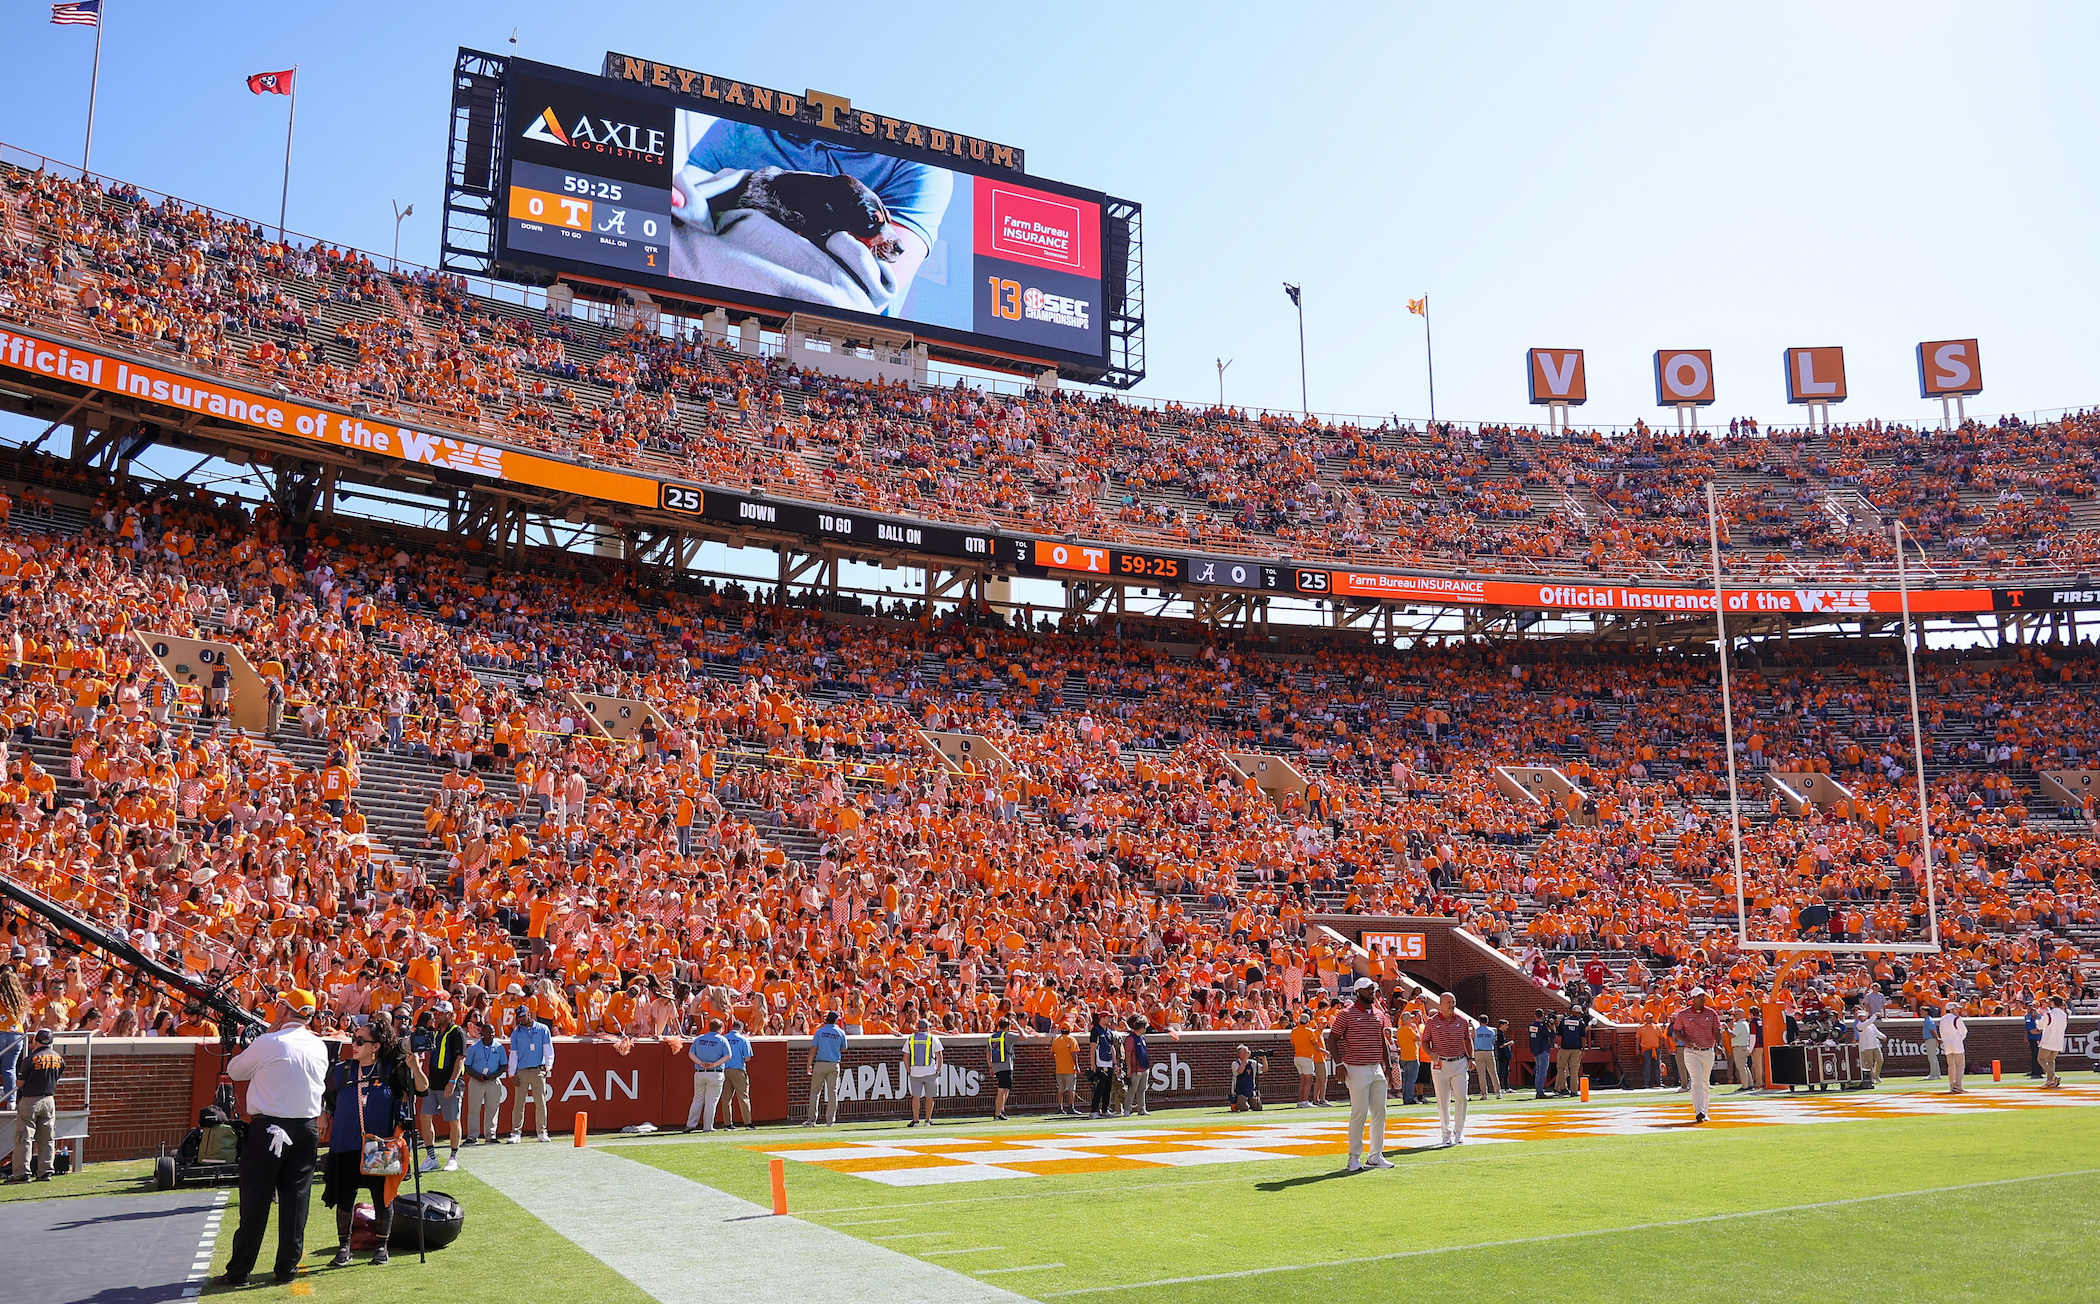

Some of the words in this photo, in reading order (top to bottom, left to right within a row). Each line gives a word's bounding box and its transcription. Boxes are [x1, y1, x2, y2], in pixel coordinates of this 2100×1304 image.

[622, 57, 797, 117] NEYLAND
[859, 112, 1014, 168] STADIUM
[571, 115, 665, 157] AXLE
[572, 139, 664, 166] LOGISTICS
[563, 175, 622, 201] 59:25
[528, 197, 544, 216] 0
[560, 199, 588, 227] T
[643, 219, 657, 237] 0
[1004, 215, 1032, 233] Farm
[1033, 221, 1069, 239] Bureau
[520, 222, 543, 233] DOWN
[560, 229, 571, 238] TO
[572, 231, 582, 240] GO
[600, 237, 615, 247] BALL
[616, 239, 628, 248] ON
[644, 245, 658, 254] QTR
[1003, 226, 1069, 251] INSURANCE
[647, 255, 656, 268] 1
[988, 275, 1022, 322] 13
[1043, 293, 1089, 319] SEC
[1025, 306, 1090, 330] CHAMPIONSHIPS
[117, 364, 283, 429] Insurance
[296, 413, 327, 438] of
[339, 418, 390, 452] the
[667, 486, 699, 511] 25
[739, 501, 776, 523] DOWN
[818, 514, 834, 532] TO
[835, 517, 852, 535] GO
[878, 523, 905, 543] BALL
[906, 528, 922, 546] ON
[965, 535, 986, 554] QTR
[988, 539, 995, 555] 1
[1015, 540, 1028, 549] TOL
[1017, 549, 1026, 561] 3
[1052, 546, 1068, 564] 0
[1083, 548, 1104, 571] T
[1120, 555, 1178, 577] 59:25
[1231, 565, 1247, 584] 0
[1265, 568, 1278, 577] TOL
[1267, 576, 1276, 588] 3
[1301, 572, 1327, 590] 25
[1349, 574, 1377, 588] Farm
[1379, 576, 1416, 589] Bureau
[1417, 578, 1484, 593] INSURANCE
[1539, 586, 1614, 608] Official
[1621, 589, 1719, 611] Insurance
[1728, 591, 1748, 610] of
[1756, 591, 1791, 611] the
[2006, 590, 2024, 607] T
[203, 651, 212, 662] J
[621, 707, 629, 717] K
[962, 742, 969, 751] L
[1259, 762, 1267, 771] M
[327, 774, 340, 790] 16
[1535, 774, 1542, 782] N
[297, 889, 307, 902] 5
[772, 991, 787, 1008] 16
[502, 1006, 515, 1026] 16
